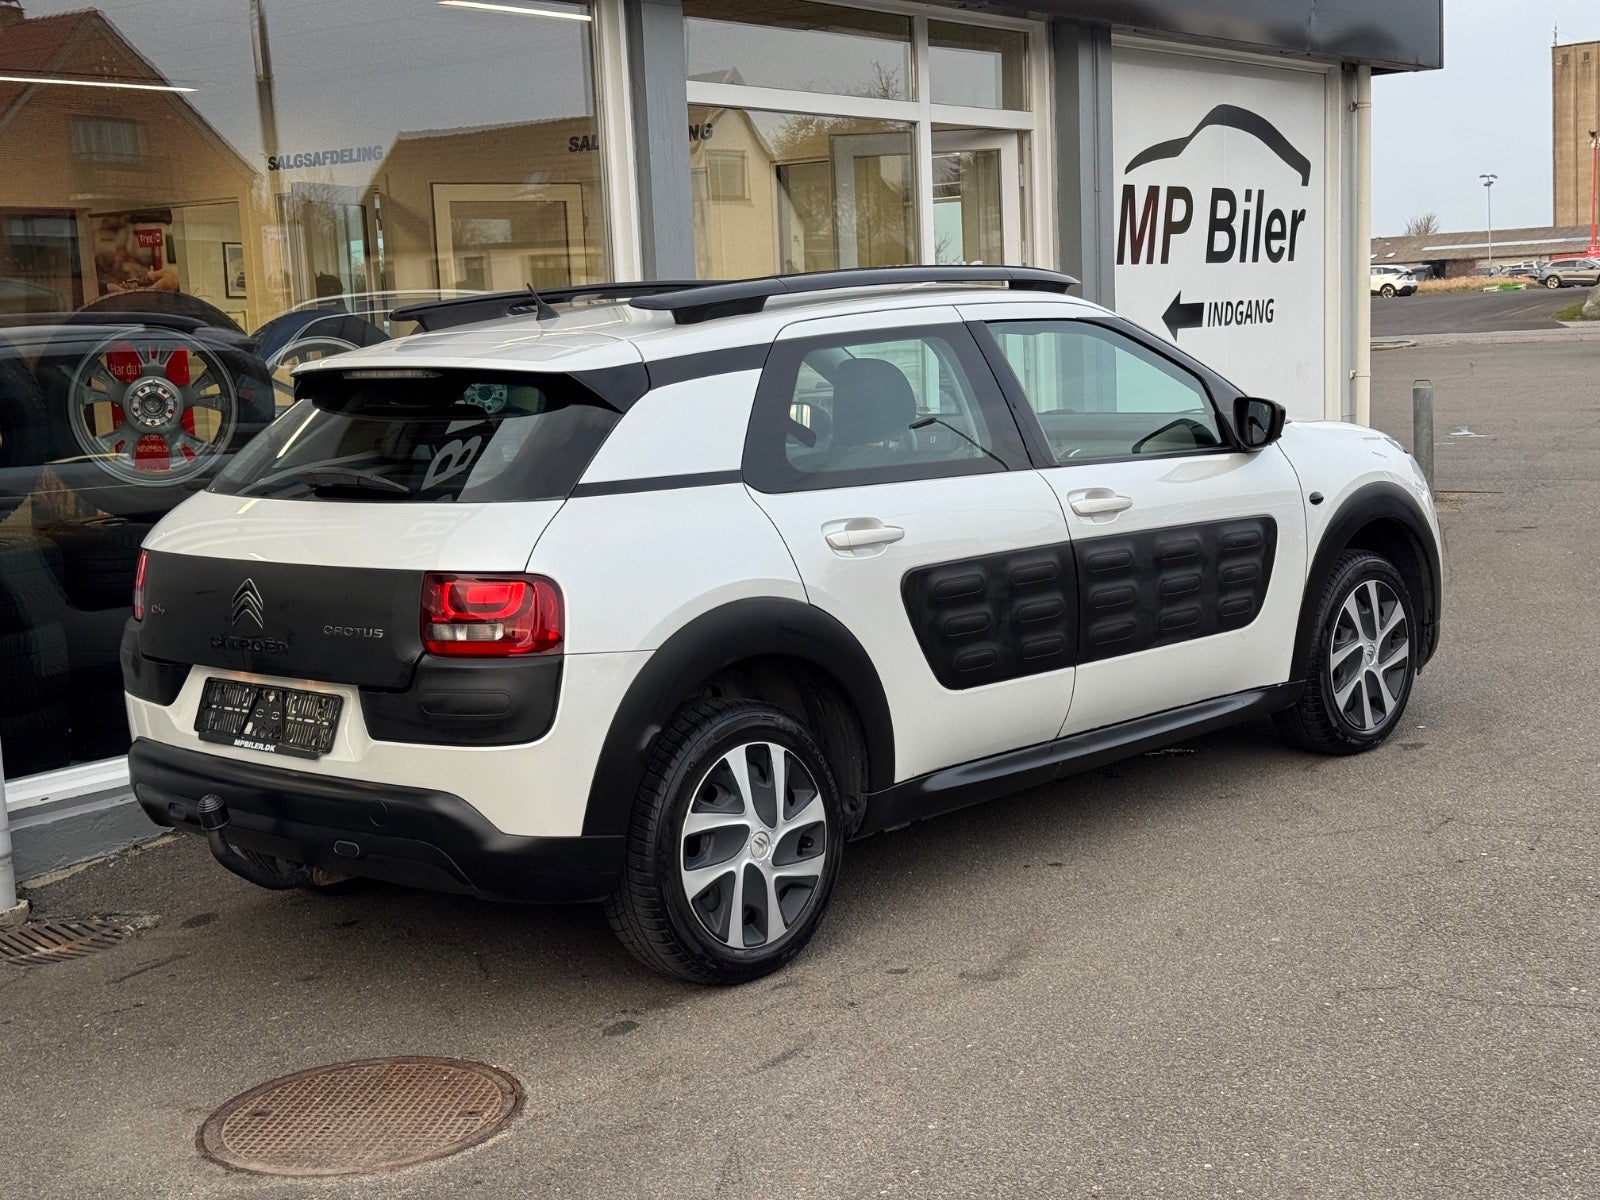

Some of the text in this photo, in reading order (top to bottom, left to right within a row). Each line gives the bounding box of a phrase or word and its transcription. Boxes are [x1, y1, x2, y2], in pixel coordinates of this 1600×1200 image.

[267, 145, 383, 171] SALGSAFDELING
[1116, 184, 1306, 265] MP Biler
[1207, 299, 1275, 328] INDGANG
[110, 362, 125, 376] Har
[126, 362, 137, 376] du
[323, 624, 384, 639] CACTUS
[234, 738, 276, 752] MPBILER.DK
